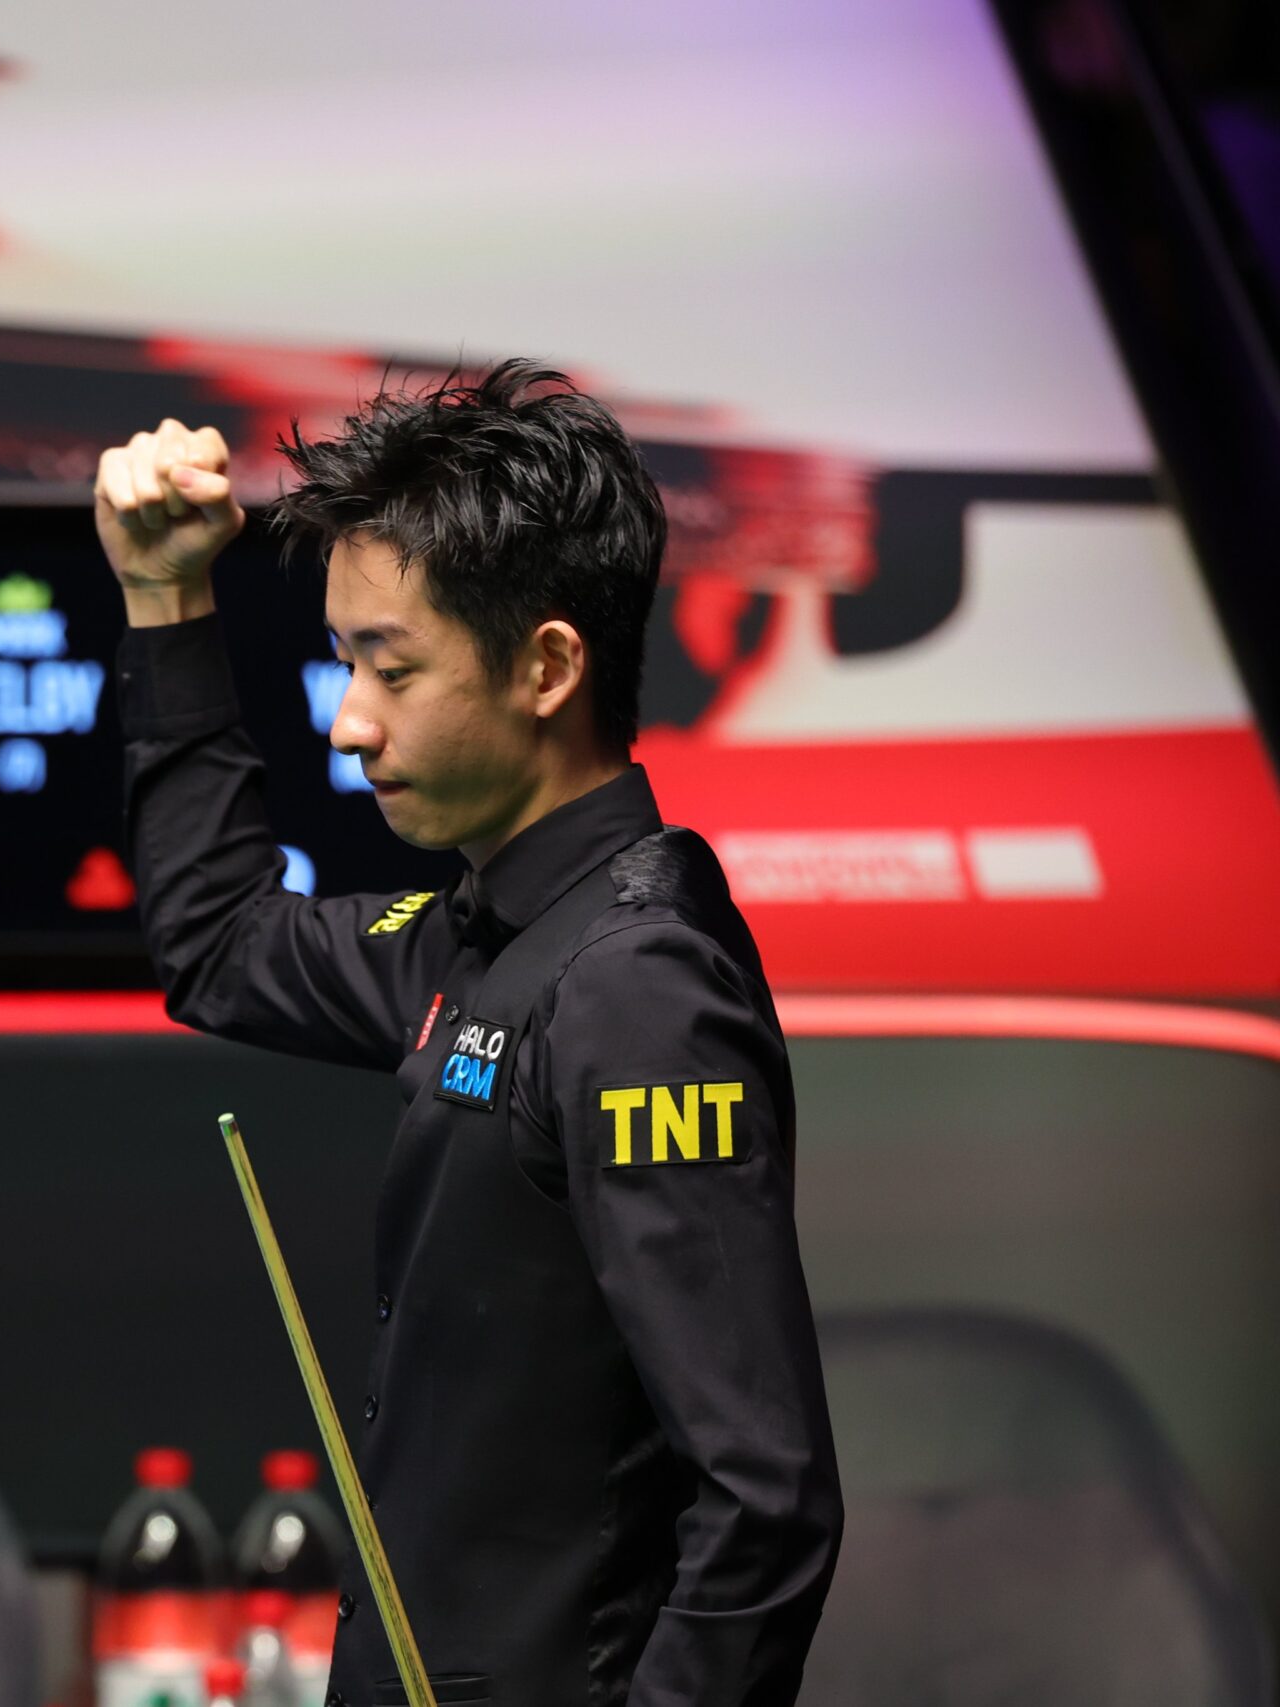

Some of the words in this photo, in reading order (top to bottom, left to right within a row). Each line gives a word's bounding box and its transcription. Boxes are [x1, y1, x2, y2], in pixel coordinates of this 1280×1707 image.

[453, 1024, 505, 1060] HALO
[442, 1053, 496, 1100] CRM
[600, 1082, 744, 1165] TNT
